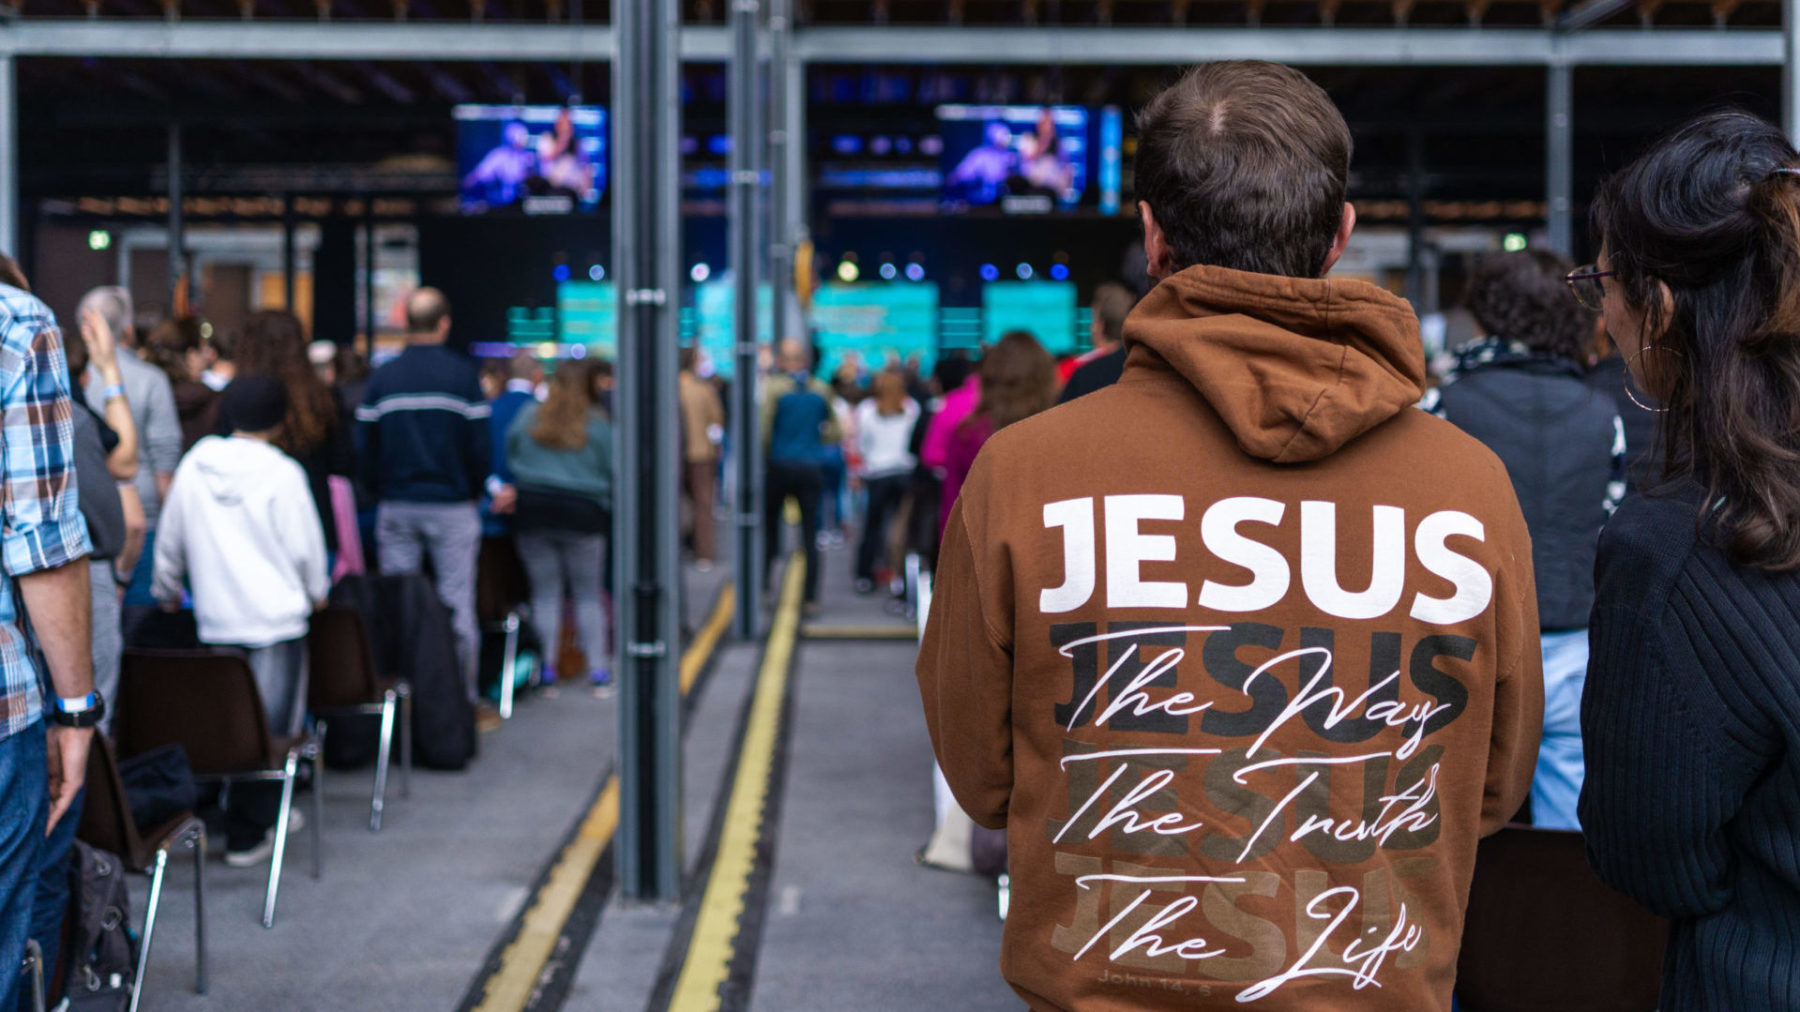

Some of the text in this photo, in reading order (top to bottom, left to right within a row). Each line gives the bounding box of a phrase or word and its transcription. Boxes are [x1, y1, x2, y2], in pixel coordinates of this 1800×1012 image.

[1040, 493, 1493, 625] JESUS
[1049, 620, 1479, 744] JESUS
[1059, 625, 1452, 760] The Way
[1053, 748, 1440, 864] The Truth
[1074, 873, 1423, 1003] The Life
[1098, 969, 1152, 988] John
